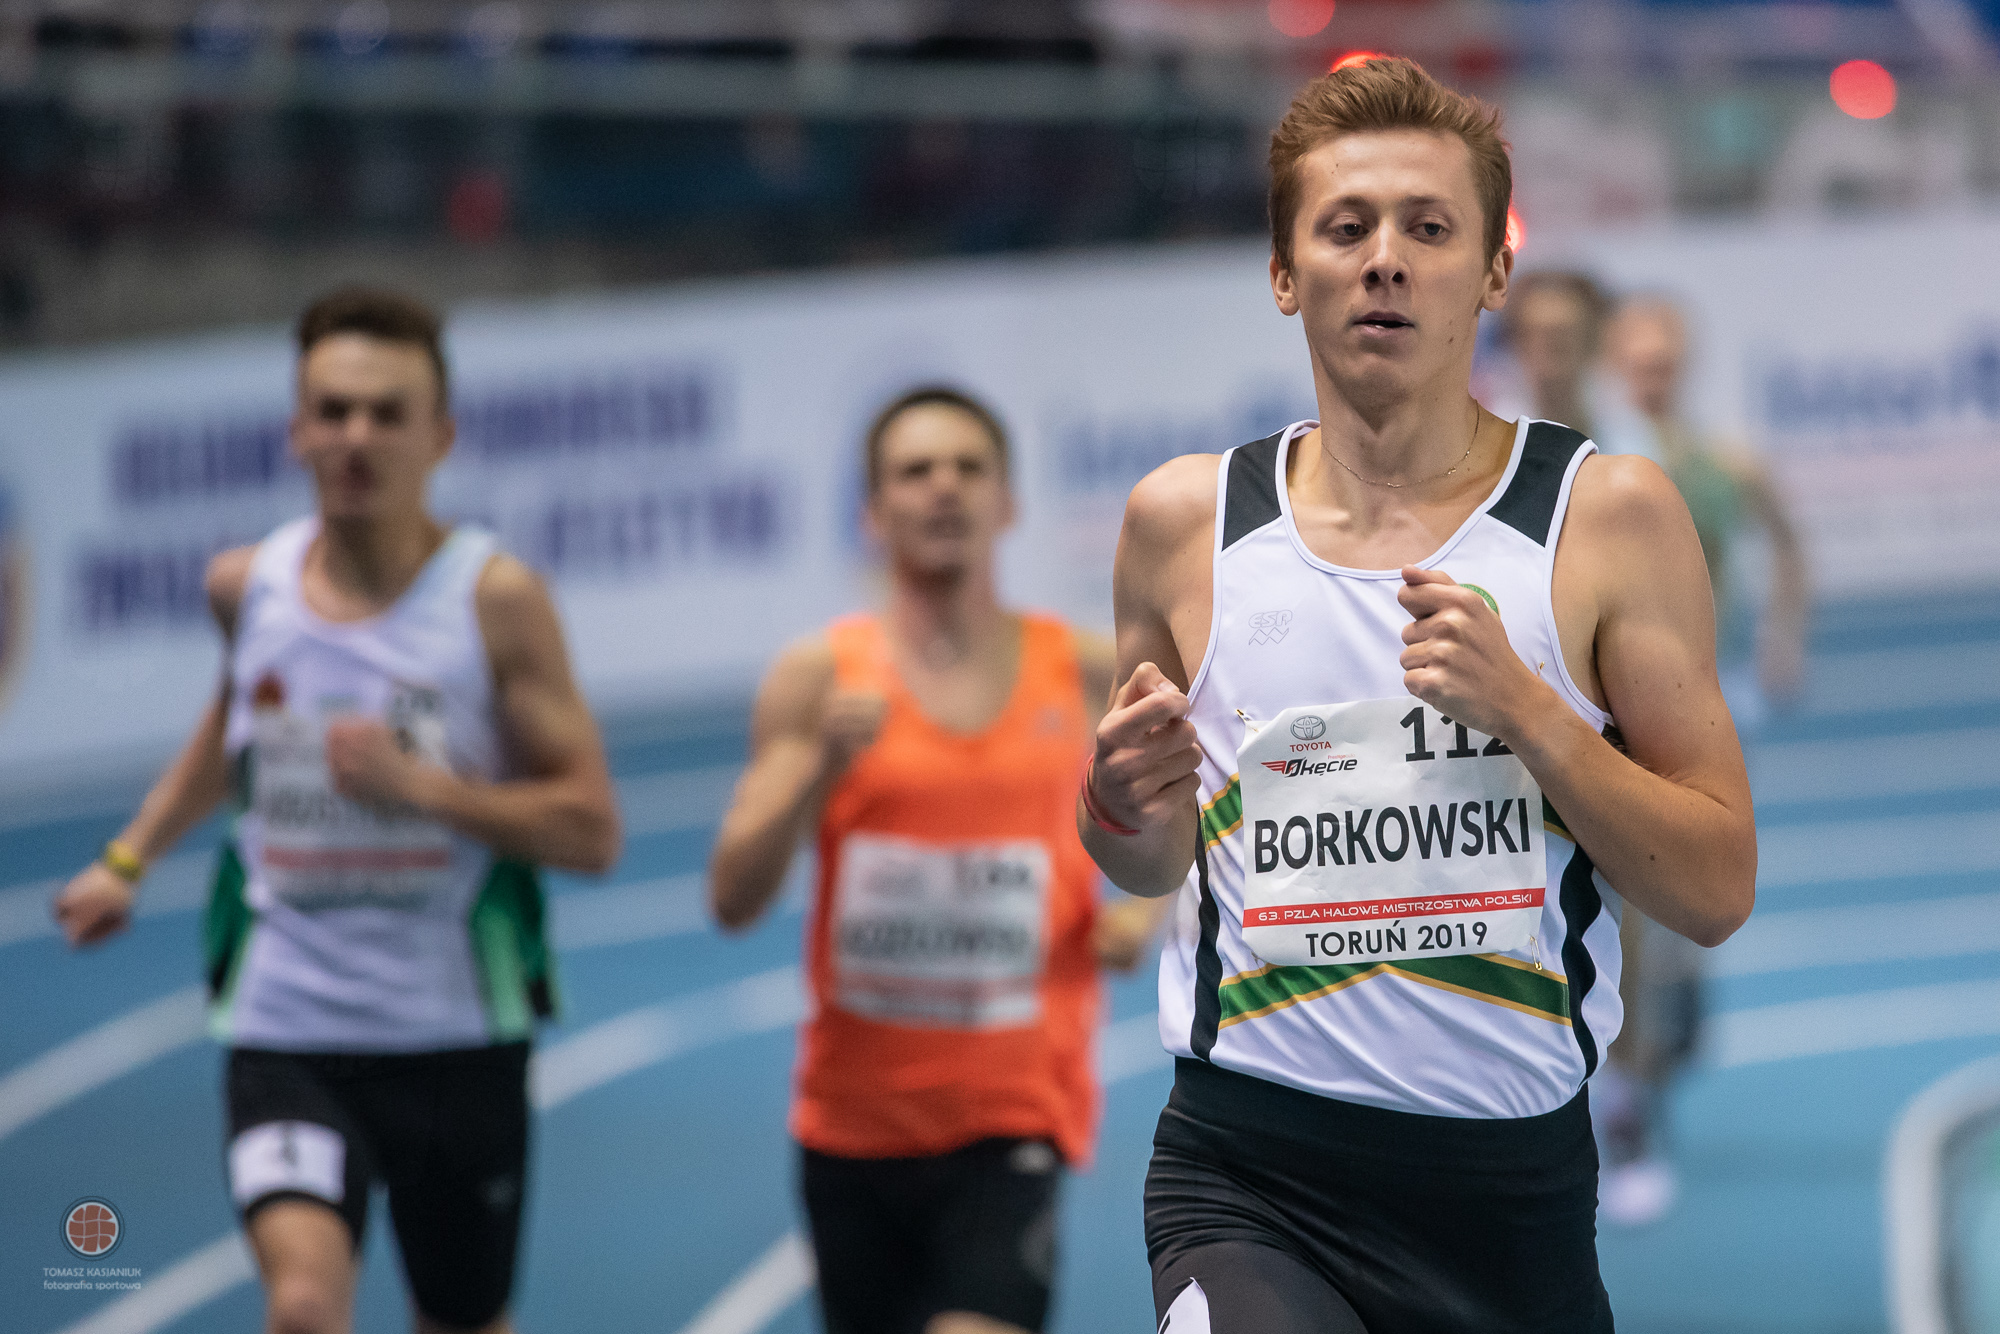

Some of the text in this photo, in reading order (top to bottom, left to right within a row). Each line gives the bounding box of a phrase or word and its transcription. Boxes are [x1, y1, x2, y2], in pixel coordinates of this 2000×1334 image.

[1289, 740, 1332, 753] TOYOTA
[1254, 798, 1531, 874] BORKOWSKI
[1258, 893, 1532, 921] 63. PZLA HALOWE MISTRZOSTWA POLSKI
[1305, 920, 1488, 958] TORUŃ 2019
